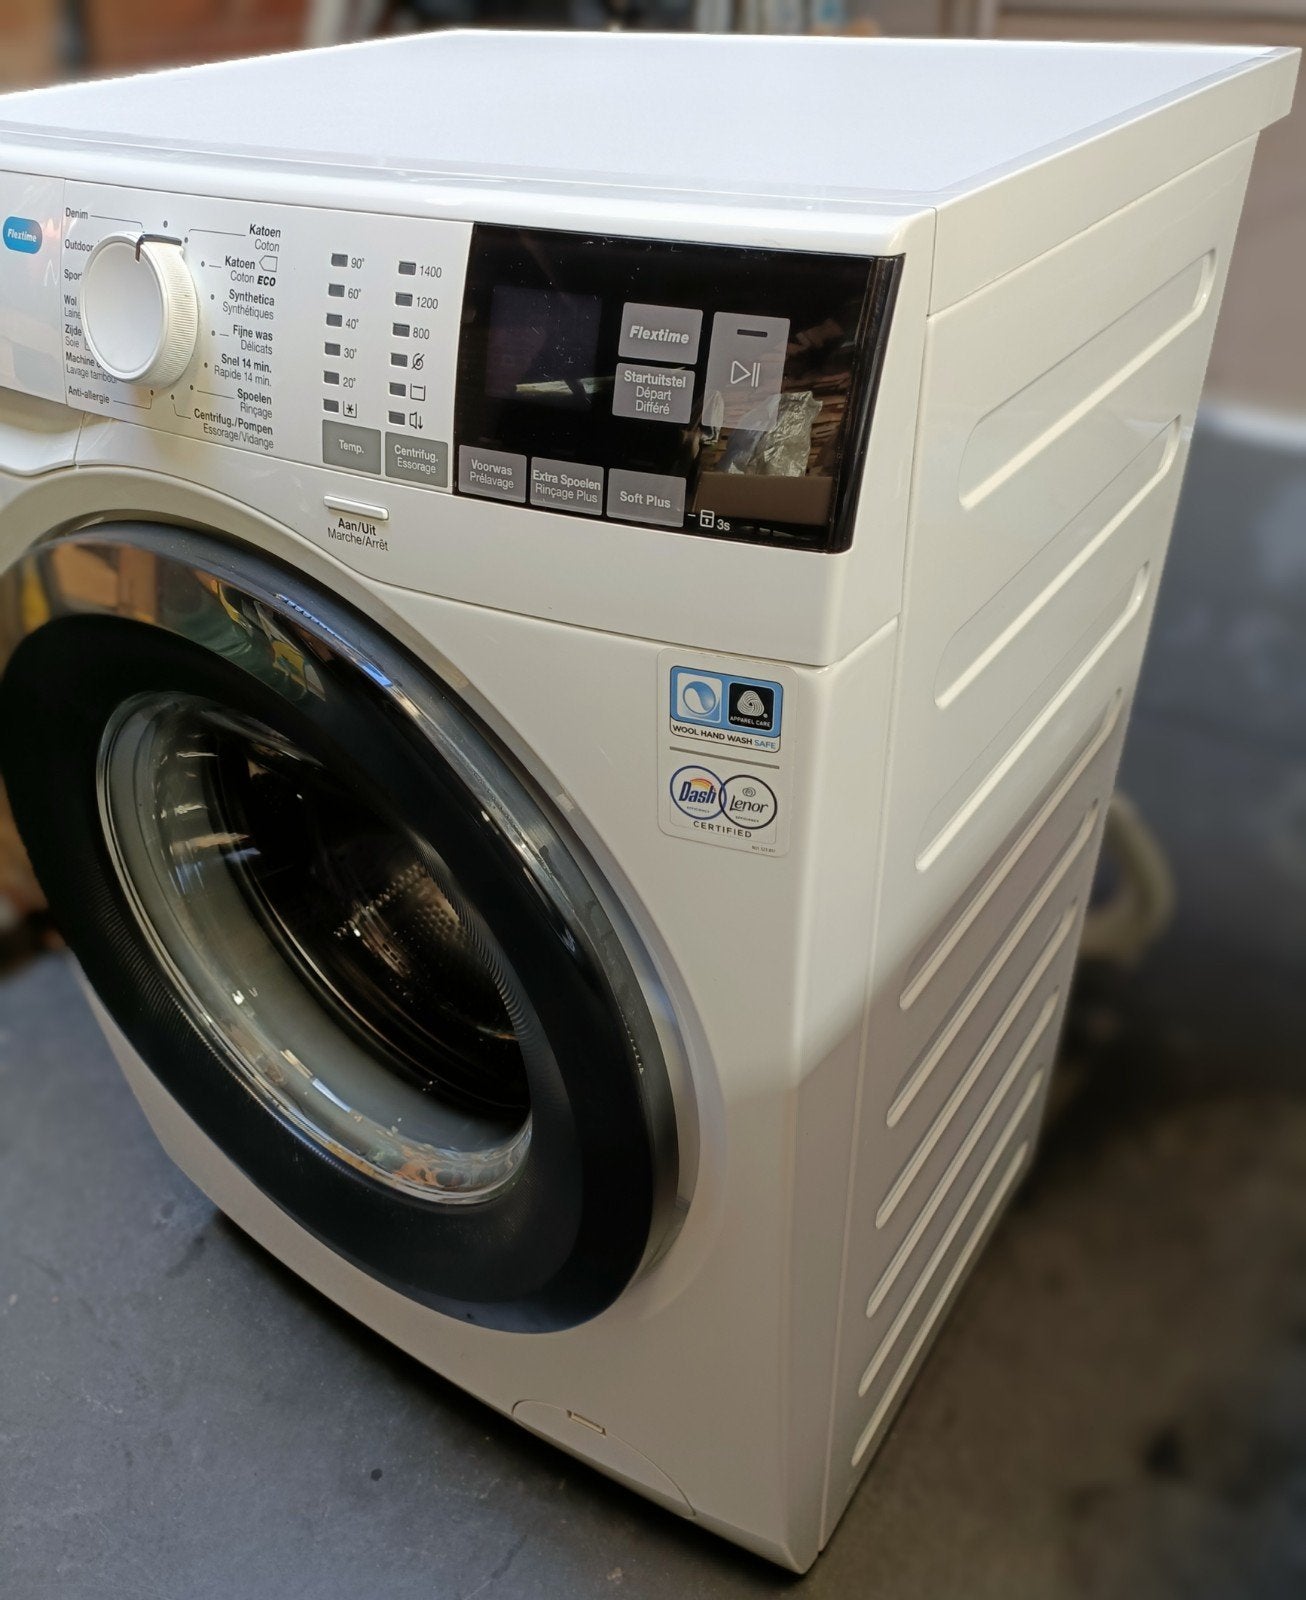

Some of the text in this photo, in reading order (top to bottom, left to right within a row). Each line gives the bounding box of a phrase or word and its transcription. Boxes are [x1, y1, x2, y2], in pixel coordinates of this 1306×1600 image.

[65, 207, 89, 220] Denim
[7, 228, 37, 243] Flextime
[249, 223, 281, 238] Katoen
[64, 238, 94, 252] Outdoor
[254, 239, 280, 252] Coton
[225, 255, 256, 270] Katoen
[351, 257, 365, 269] 90°
[64, 269, 82, 281] Spor
[230, 270, 276, 287] Coton ECO
[419, 265, 443, 279] 1400
[63, 294, 77, 306] Wol
[229, 289, 275, 306] Synthetica
[347, 288, 362, 300] 60°
[222, 301, 274, 320] Synthétiques
[416, 296, 439, 310] 1200
[65, 323, 82, 337] Zijde
[345, 318, 359, 330] 40°
[233, 324, 273, 341] Fijne was
[412, 327, 430, 340] 800
[629, 325, 690, 344] Flextime
[65, 336, 79, 348] Soie
[240, 339, 273, 355] Délicats
[65, 351, 95, 367] Machine
[343, 348, 357, 359] 30°
[66, 363, 89, 379] Lavage
[221, 353, 272, 373] Snel 14 min.
[214, 365, 272, 387] Rapide 14 min.
[343, 377, 356, 388] 20°
[624, 370, 687, 389] Startuitstel
[68, 385, 110, 404] Anti-allergie
[237, 388, 272, 405] Spoelen
[636, 385, 672, 401] Départ
[240, 402, 273, 420] Rinçage
[635, 399, 670, 415] Différé
[194, 408, 273, 435] Centrifug./Pompen
[203, 423, 274, 451] Essorage/Vidange
[338, 439, 365, 455] Temp.
[394, 444, 439, 463] Centrifug.
[397, 457, 436, 475] Essorage
[471, 458, 513, 477] Voorwas
[469, 471, 514, 489] Prélavage
[533, 469, 601, 491] Extra Spoelen
[535, 482, 598, 503] Rinçage Plus
[619, 490, 671, 509] Soft Plus
[338, 517, 376, 536] Aan/Uit
[717, 518, 731, 532] 3s
[327, 526, 389, 551] Marche/Arrêt
[730, 715, 771, 728] APPAREL CARE
[672, 724, 776, 749] WOOL HAND WASH SAFE
[679, 781, 717, 804] Dash
[729, 795, 769, 813] Lenor
[693, 820, 752, 838] CERTIFIED
